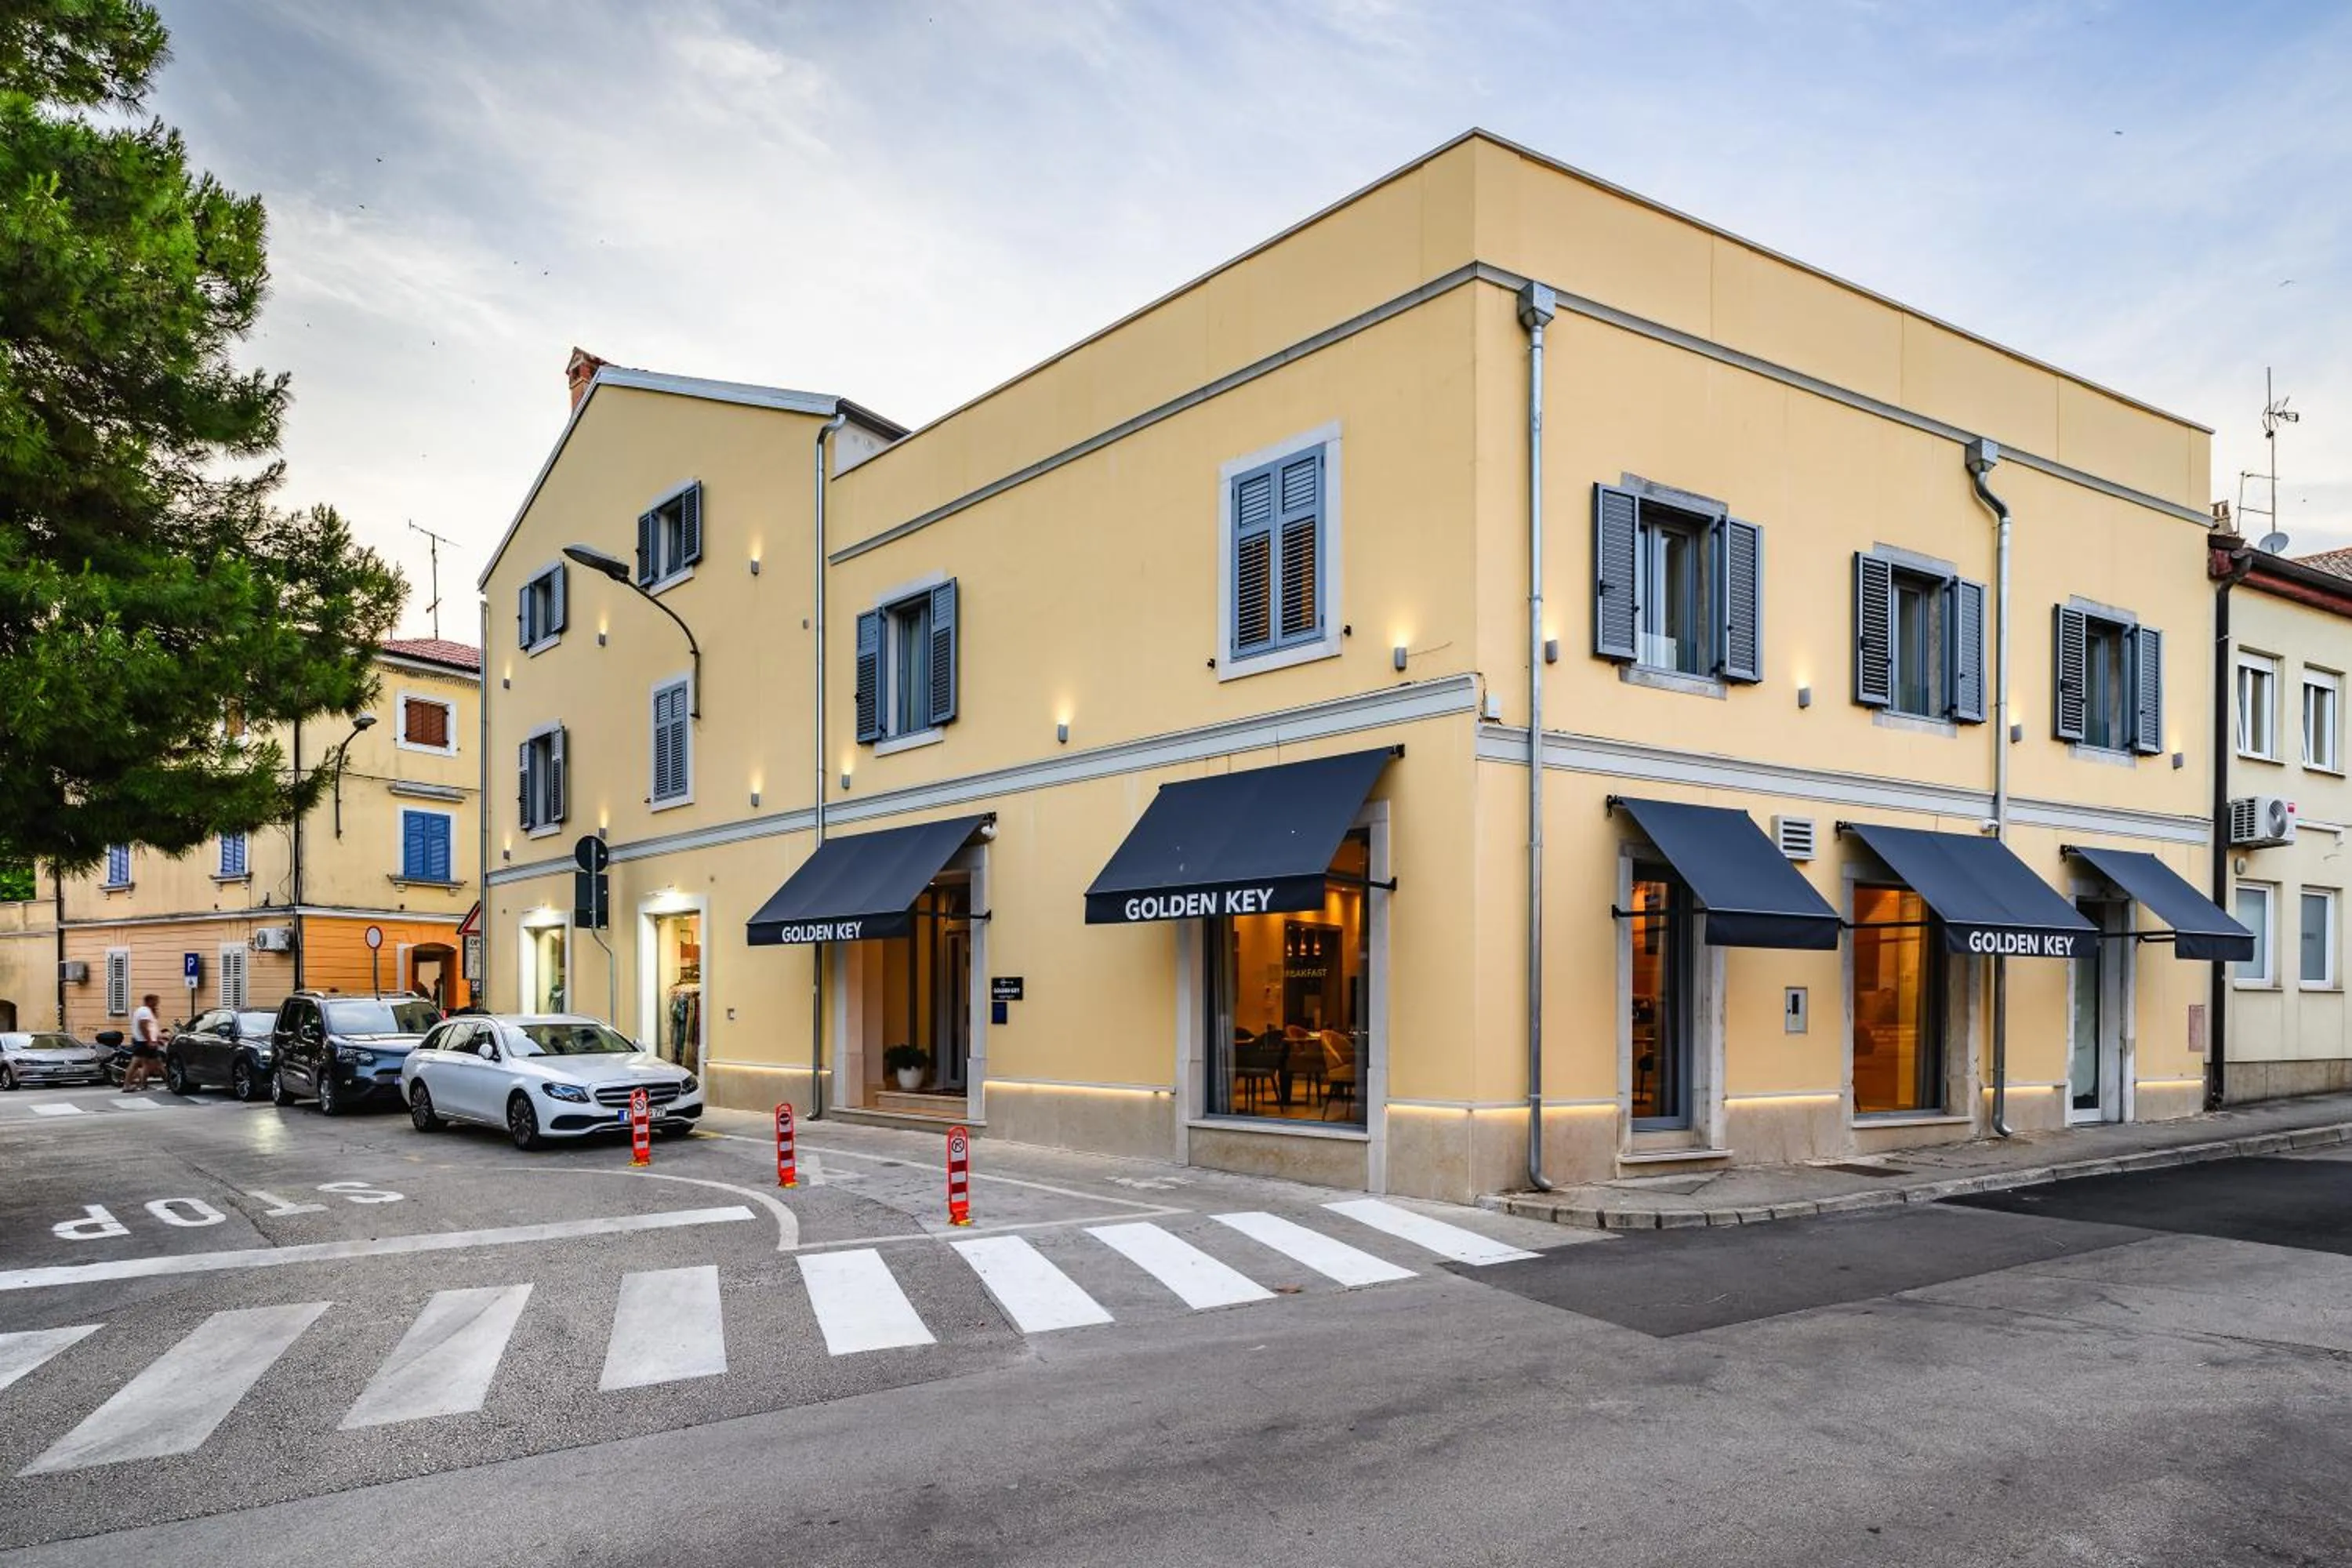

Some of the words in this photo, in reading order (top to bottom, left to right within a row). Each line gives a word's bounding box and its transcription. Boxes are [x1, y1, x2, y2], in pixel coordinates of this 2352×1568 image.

[1125, 892, 1218, 920] GOLDEN
[1225, 887, 1274, 913] KEY
[782, 924, 833, 942] GOLDEN
[837, 921, 862, 939] KEY
[1969, 931, 2038, 954] GOLDEN
[2044, 935, 2074, 956] KEY
[187, 957, 195, 973] P
[51, 1181, 405, 1240] STOP
